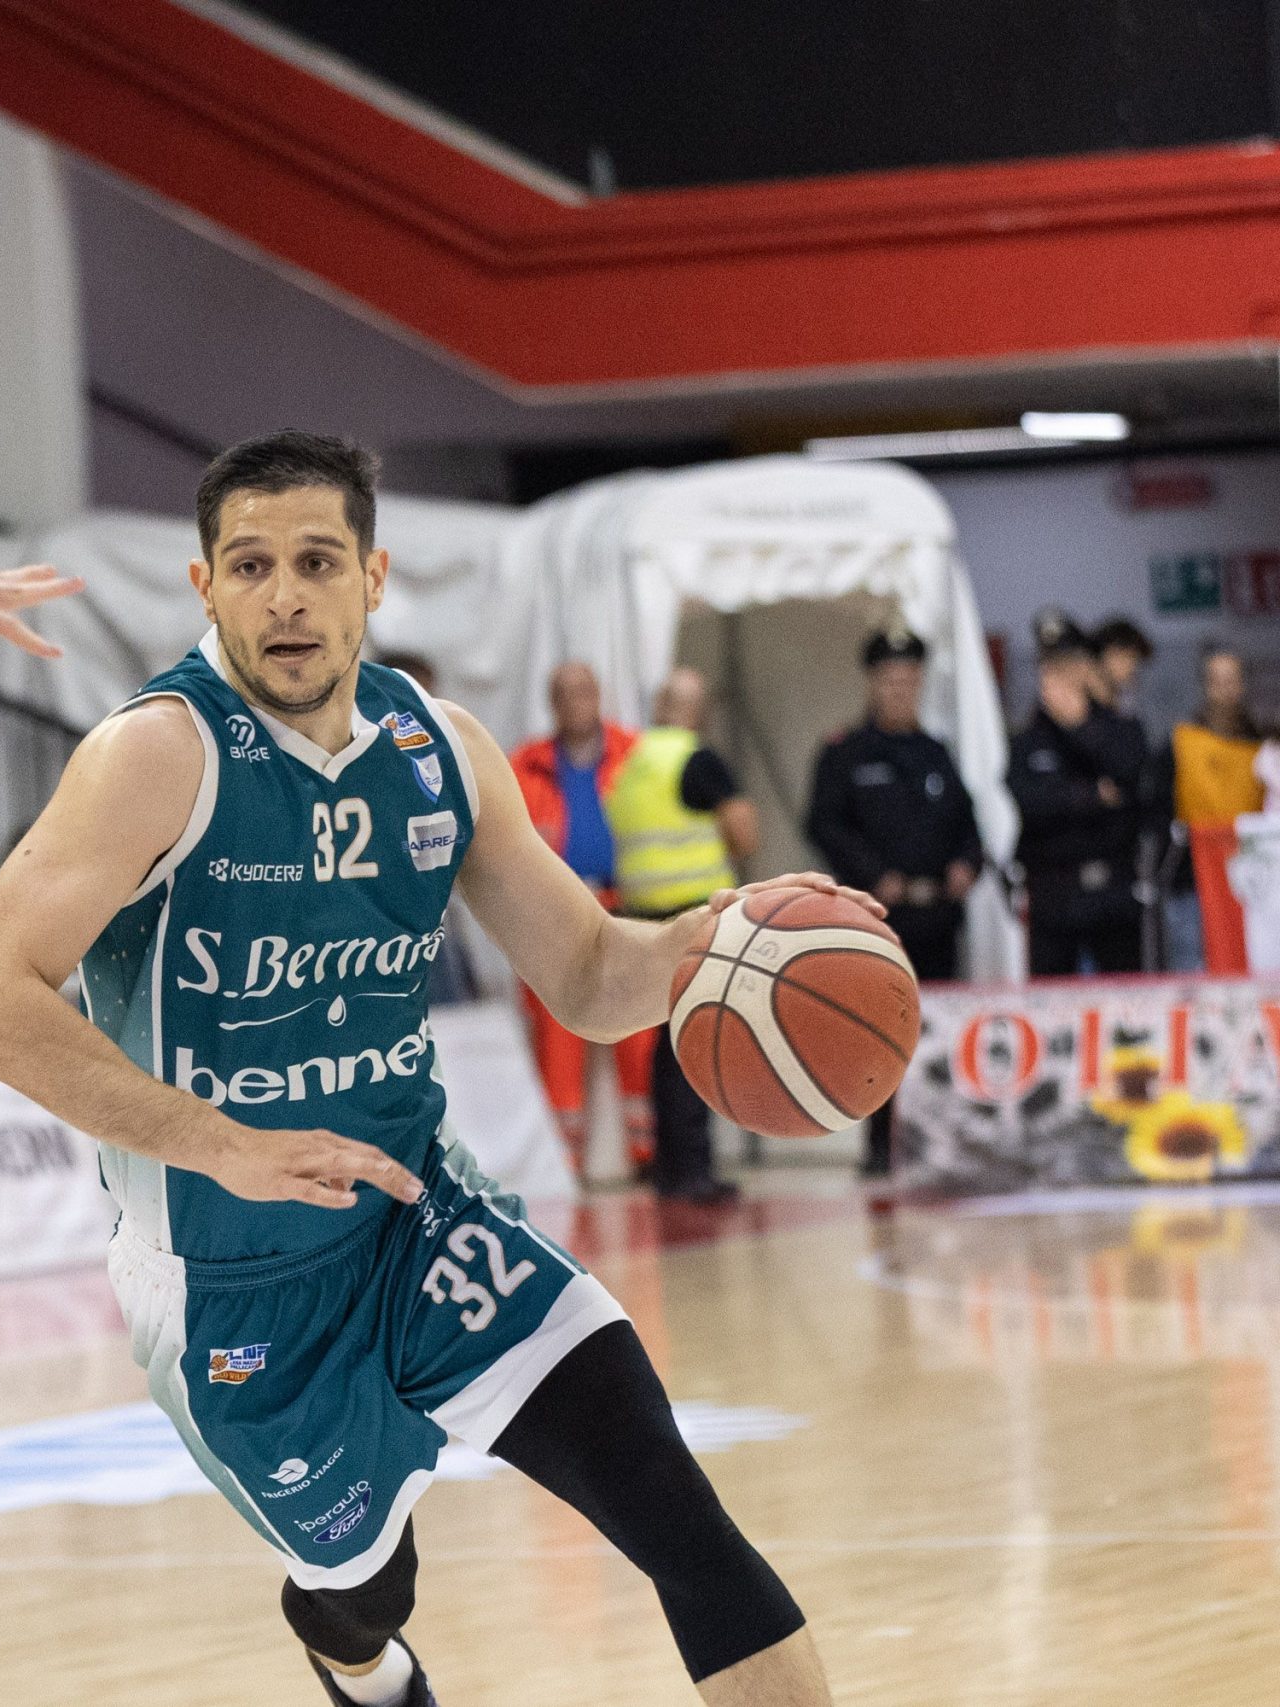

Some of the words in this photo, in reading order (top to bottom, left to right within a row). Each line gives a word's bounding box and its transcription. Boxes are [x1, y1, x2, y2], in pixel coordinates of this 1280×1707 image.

[313, 797, 380, 882] 32
[230, 863, 304, 882] KYOCERA
[422, 1223, 537, 1332] 32
[311, 1446, 345, 1480] VIAGGI
[293, 1480, 370, 1533] iperauto
[328, 1501, 367, 1541] Ford
